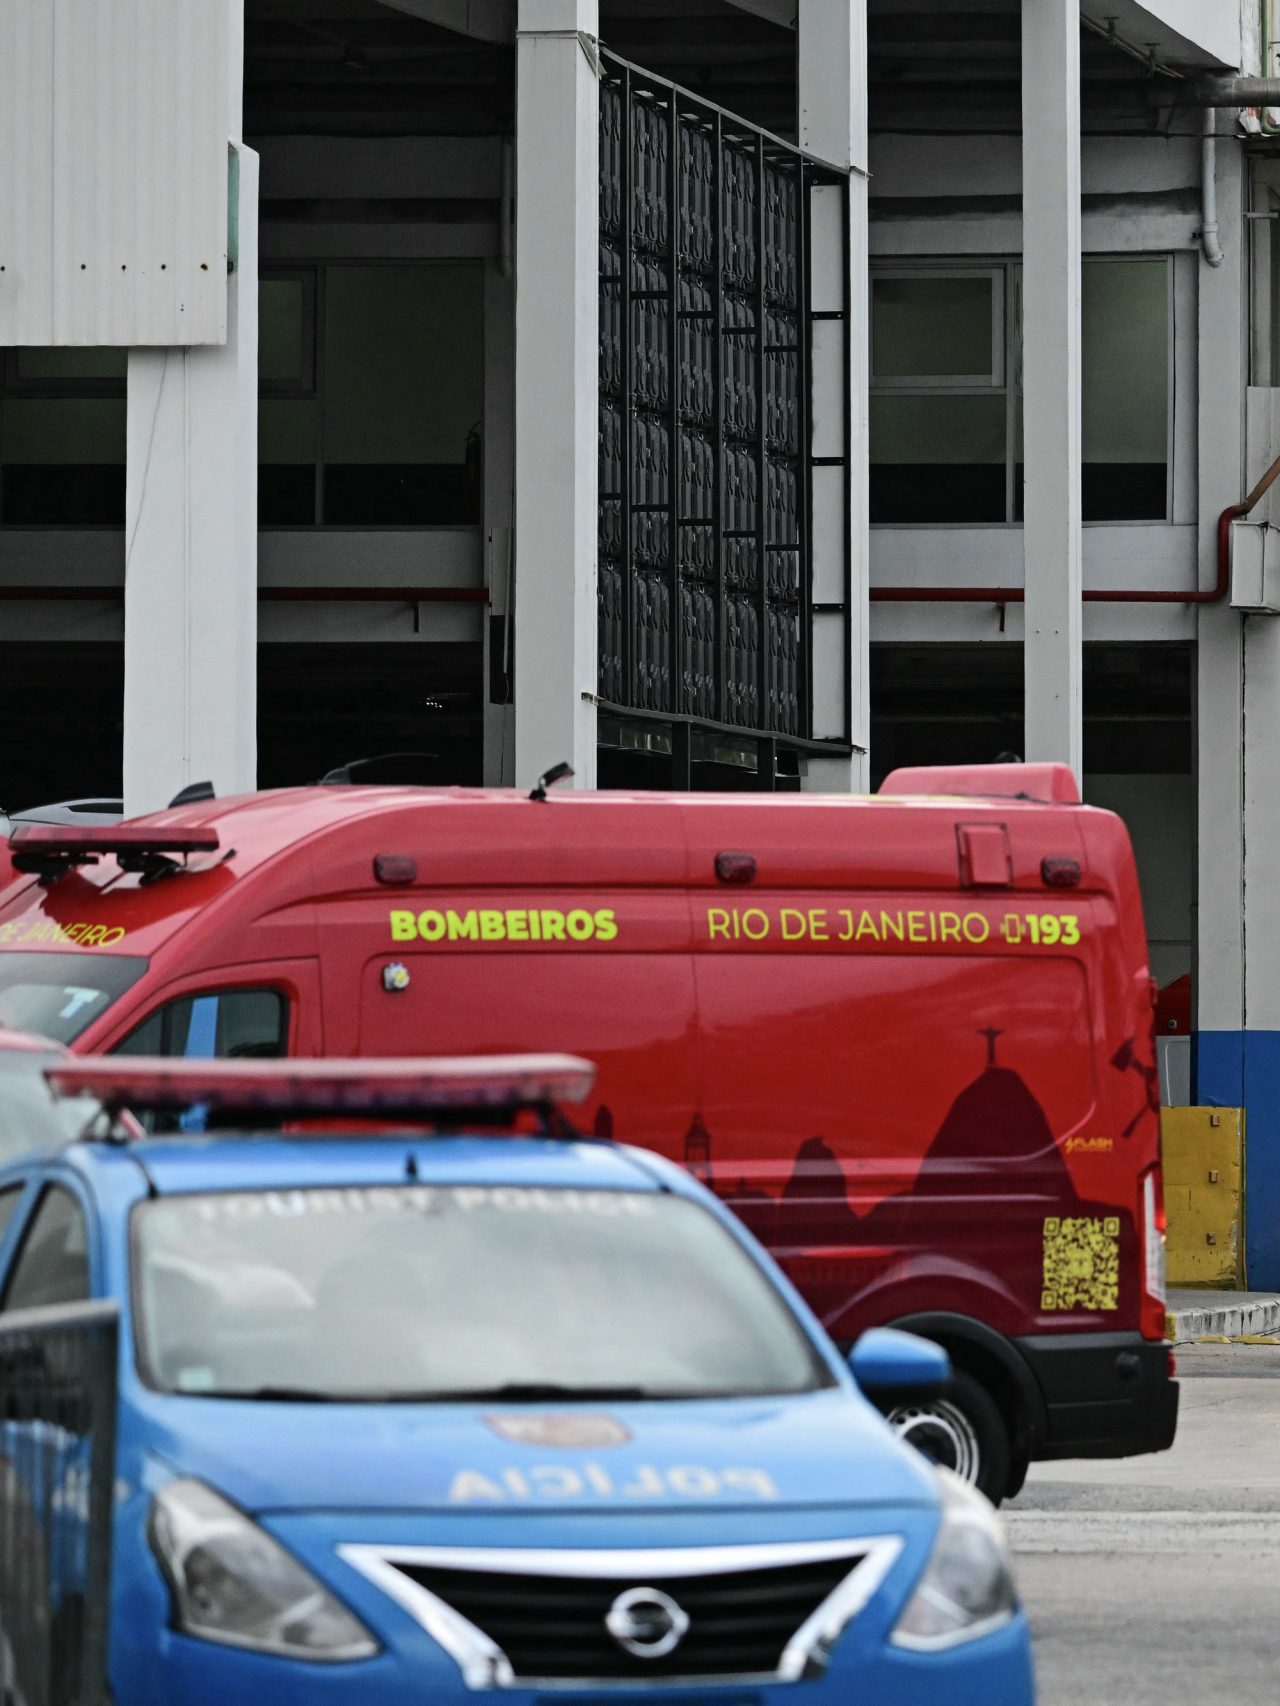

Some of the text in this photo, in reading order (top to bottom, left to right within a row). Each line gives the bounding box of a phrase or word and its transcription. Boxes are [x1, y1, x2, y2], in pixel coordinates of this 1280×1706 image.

[18, 922, 126, 948] JANEIRO
[390, 909, 618, 941] BOMBEIROS
[707, 908, 1080, 945] RIO DE JANEIRO 193
